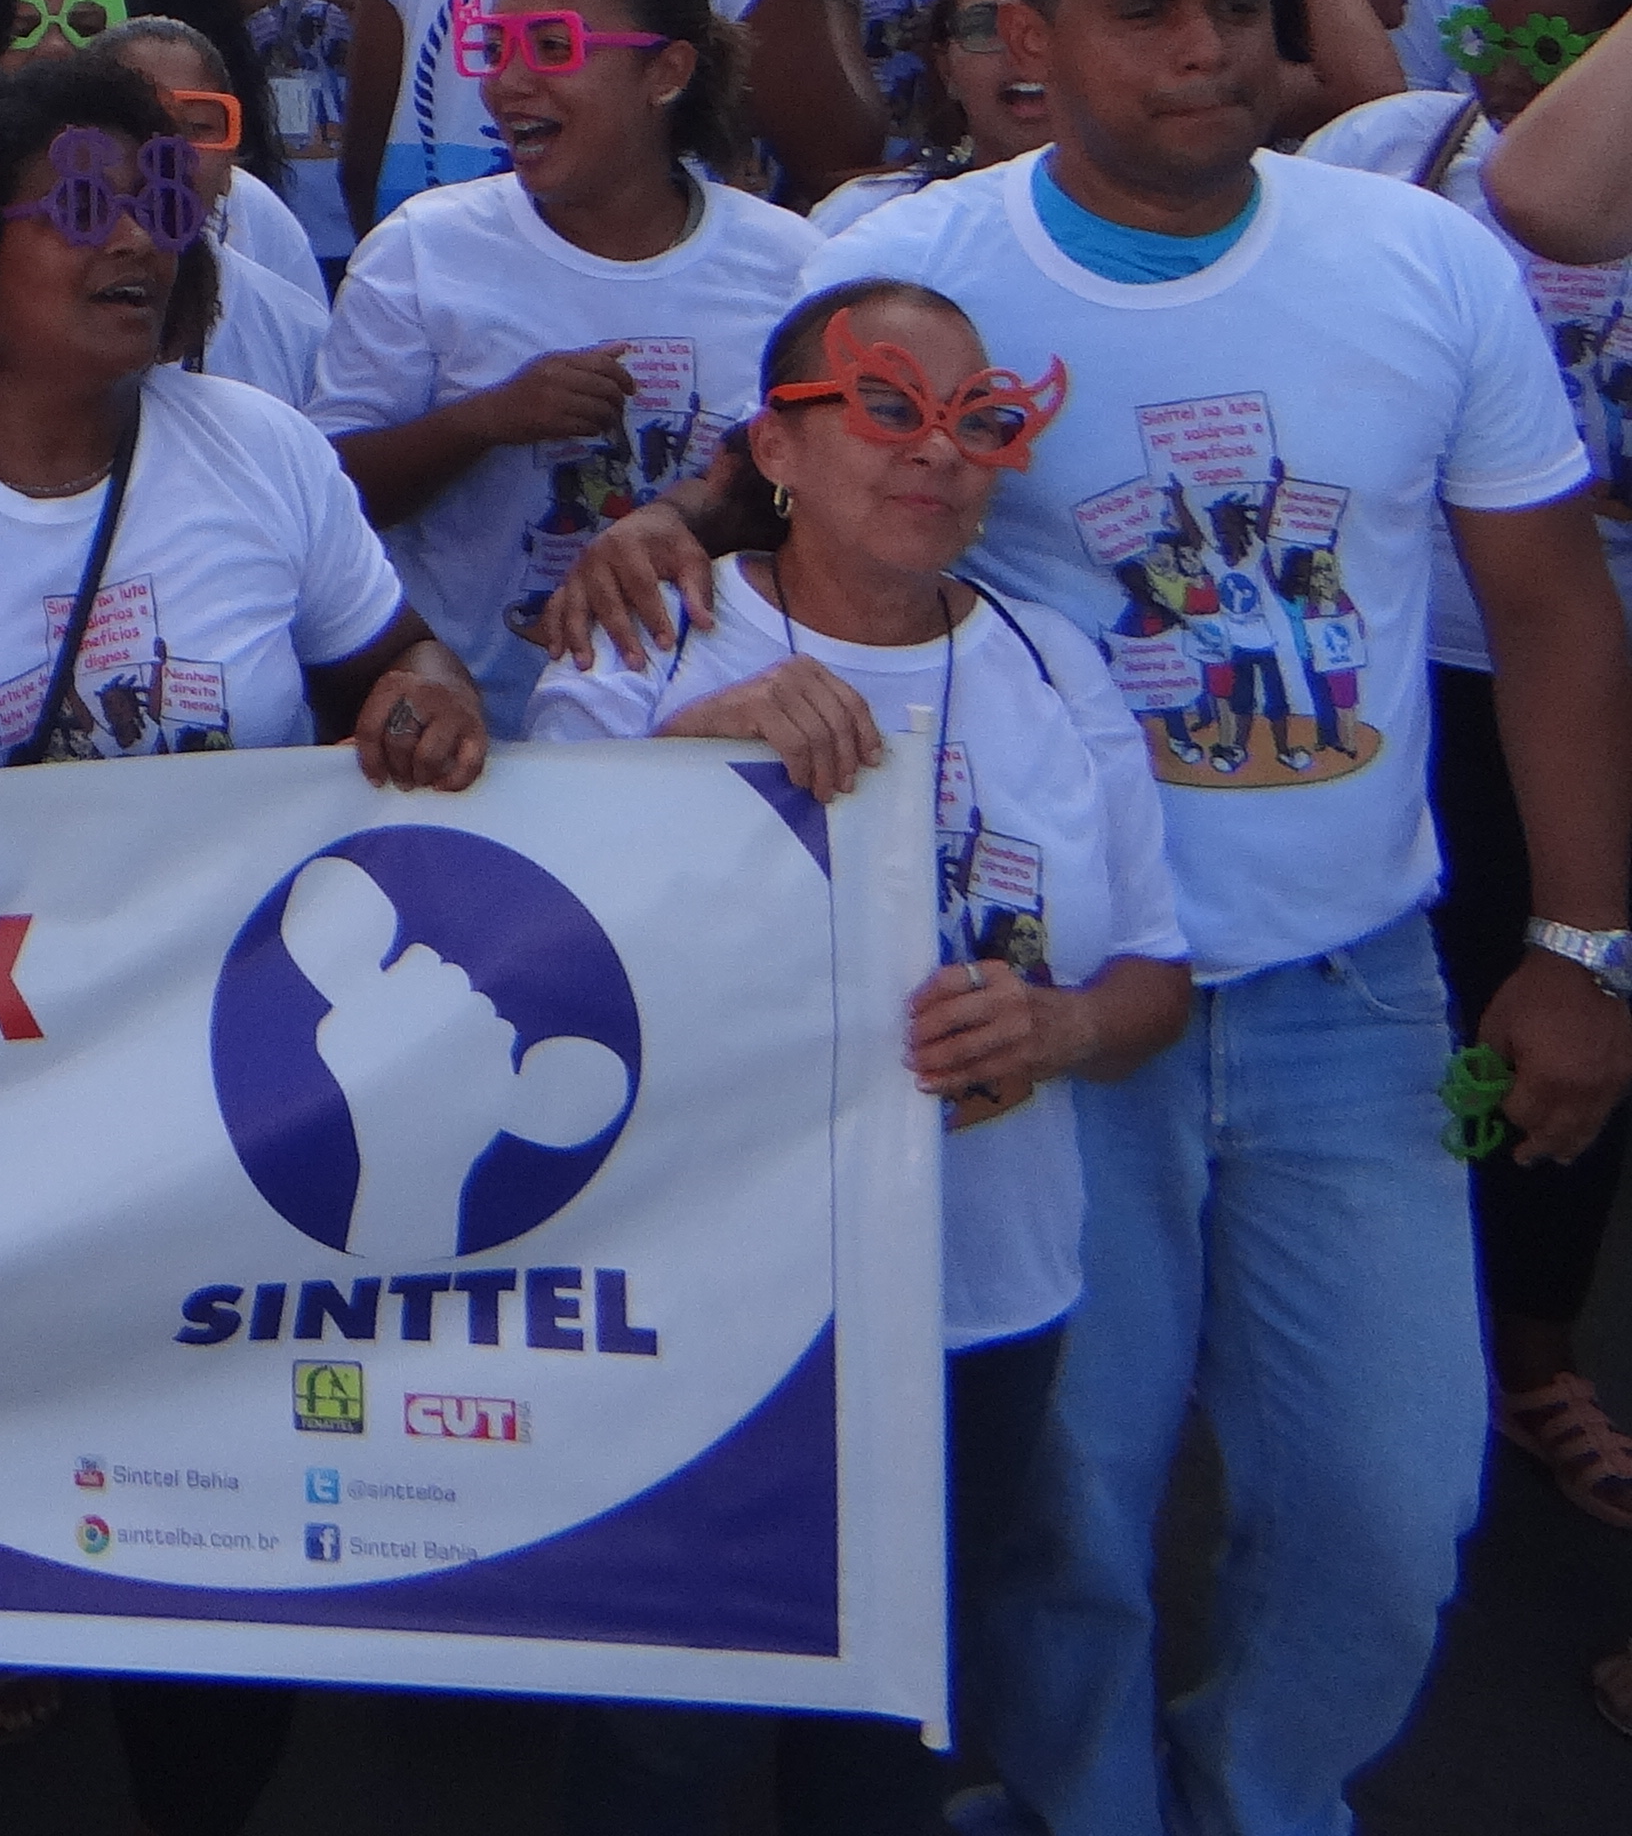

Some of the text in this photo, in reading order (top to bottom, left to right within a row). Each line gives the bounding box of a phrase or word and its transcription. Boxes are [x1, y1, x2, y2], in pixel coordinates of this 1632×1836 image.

[119, 582, 148, 602] luta
[83, 648, 131, 670] dignos
[164, 667, 220, 685] Nenhum
[173, 1266, 659, 1357] SINTTEL
[405, 1396, 513, 1439] CUT
[112, 1464, 180, 1489] Sinttel
[185, 1467, 240, 1492] Bahia
[345, 1479, 458, 1504] @sinttelba
[116, 1524, 282, 1552] sinttelba.com.br
[348, 1535, 418, 1560] Sinttel
